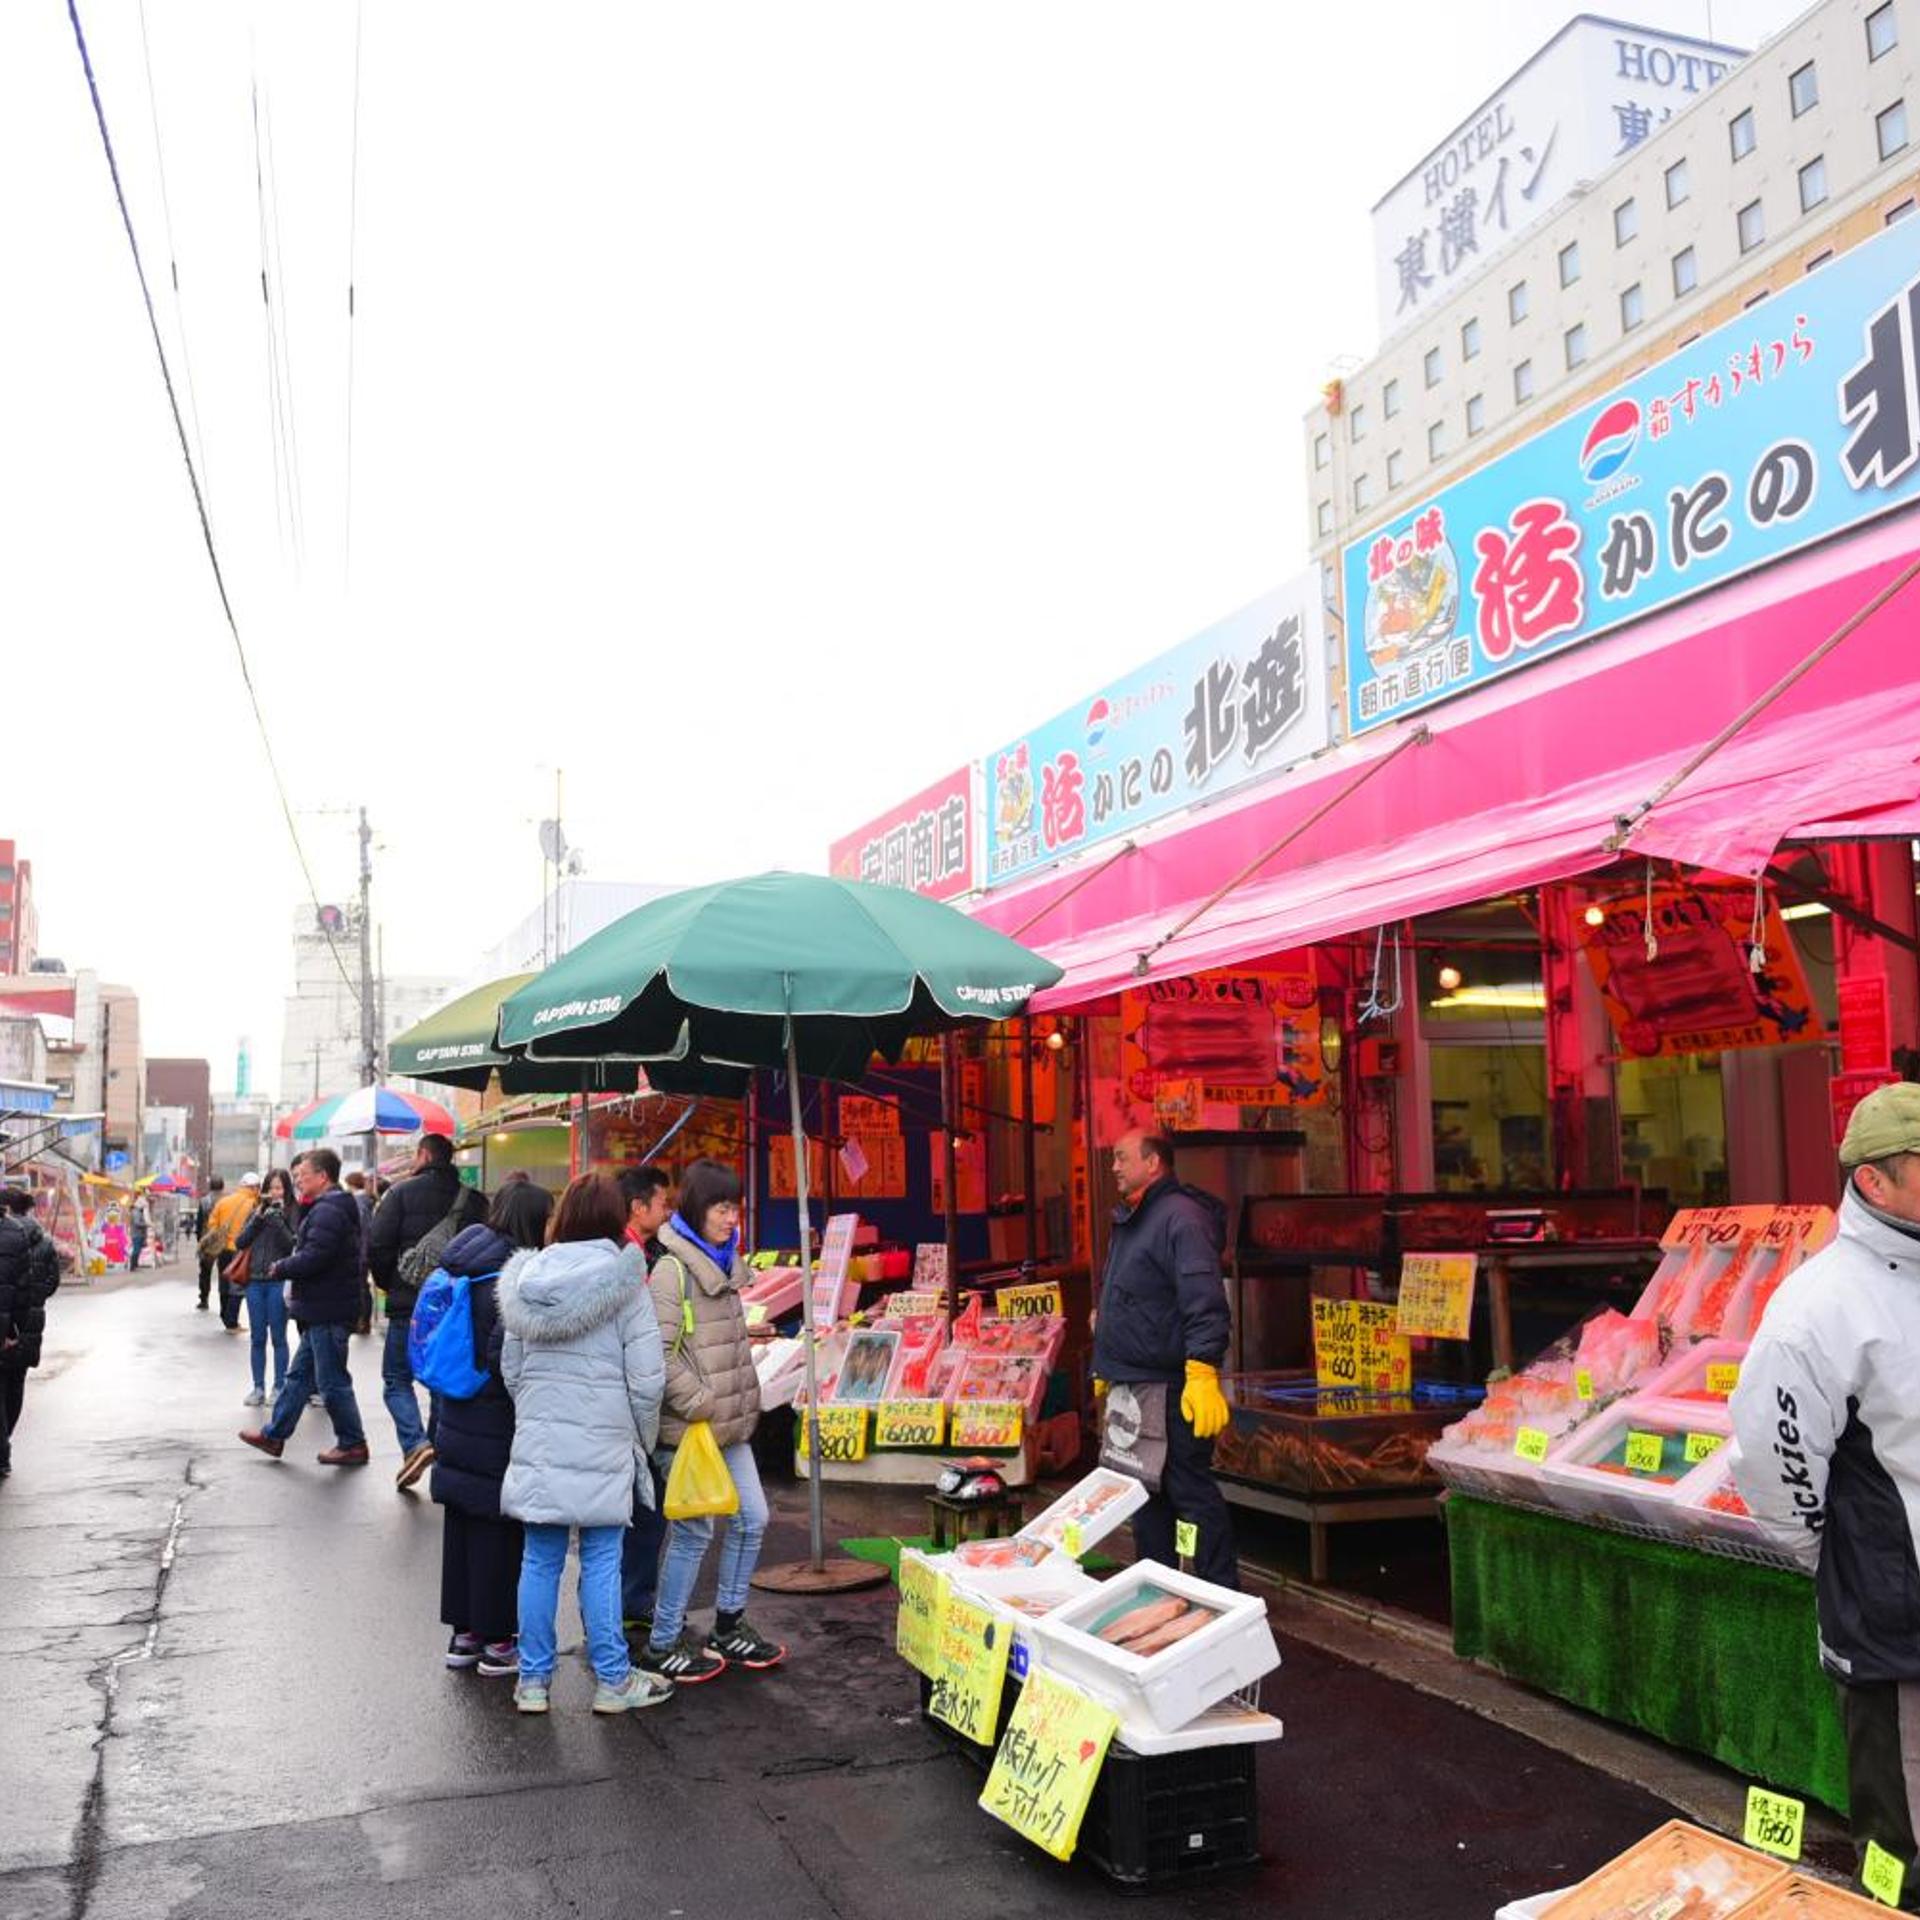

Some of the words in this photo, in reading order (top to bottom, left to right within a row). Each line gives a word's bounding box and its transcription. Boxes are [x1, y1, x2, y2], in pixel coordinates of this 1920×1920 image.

[1615, 39, 1735, 93] HOTE
[1422, 102, 1515, 208] HOTEL
[1611, 100, 1673, 158] 東
[1393, 120, 1560, 316] 東横イン
[1360, 639, 1470, 718] 朝市直行便
[586, 996, 622, 1015] STAG
[416, 1046, 459, 1062] CAPTAIN
[460, 1044, 485, 1057] STAG
